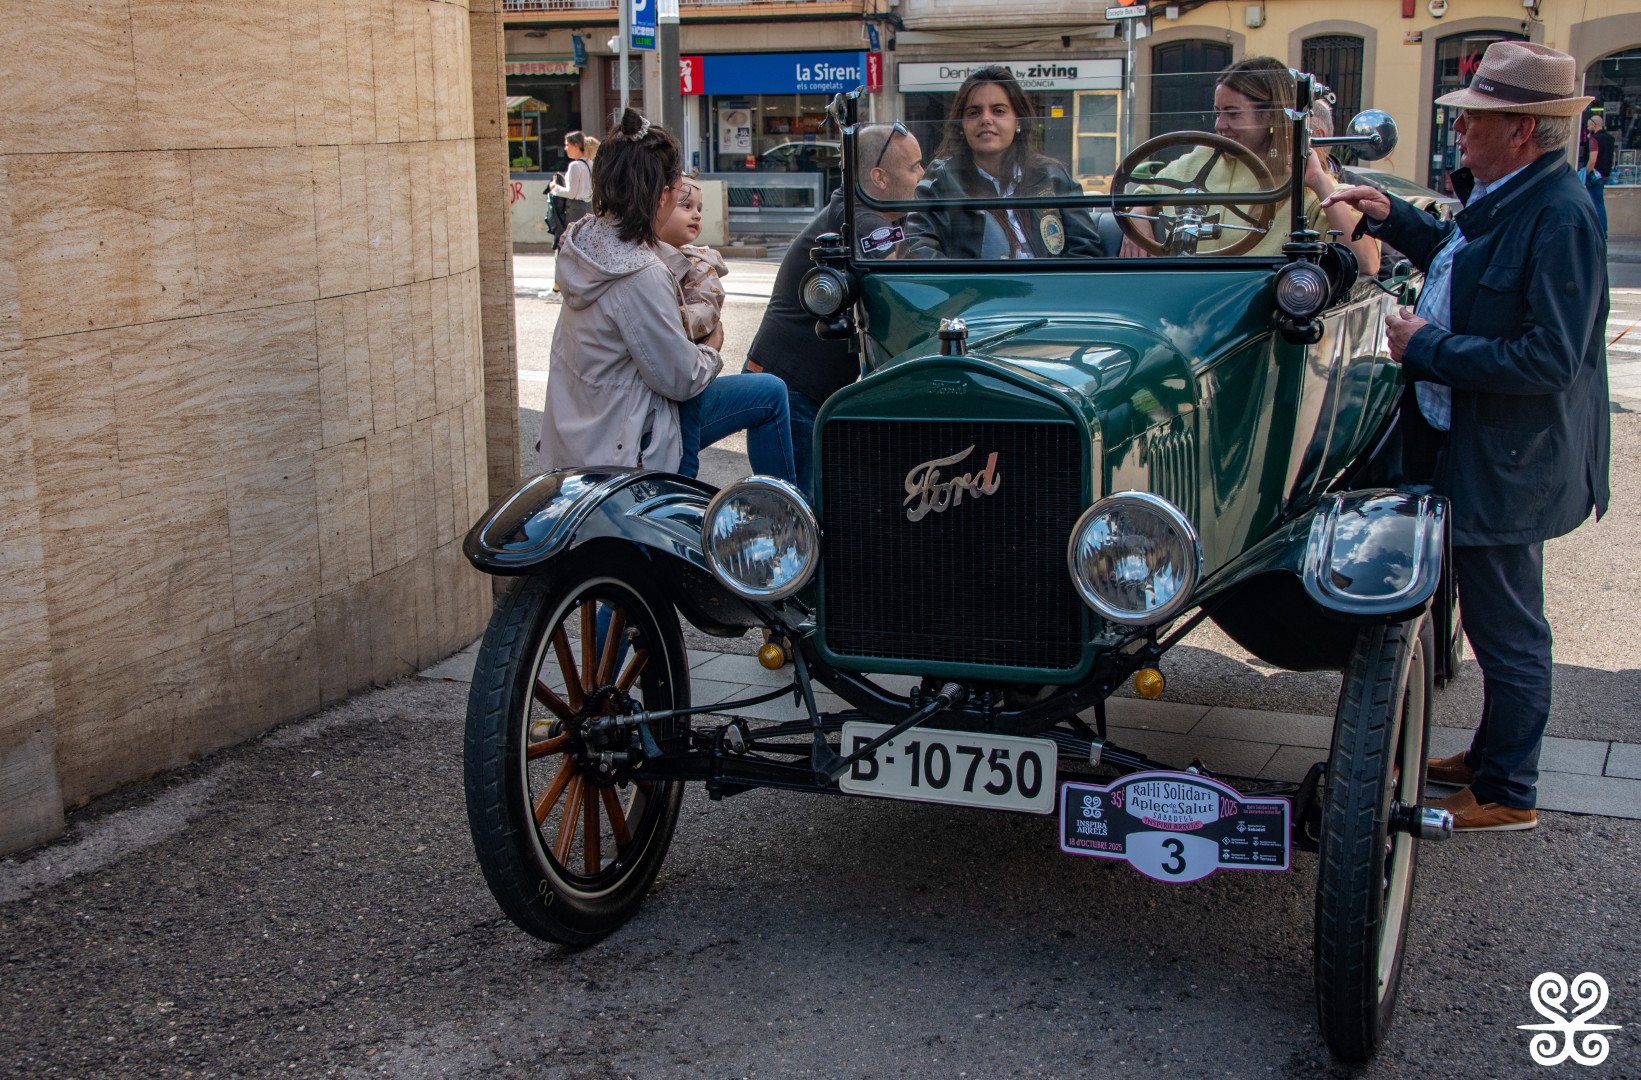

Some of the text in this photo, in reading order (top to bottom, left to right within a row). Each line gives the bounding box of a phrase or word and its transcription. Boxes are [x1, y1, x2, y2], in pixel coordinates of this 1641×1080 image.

[631, 0, 647, 25] P
[519, 62, 569, 74] MERCAT
[796, 63, 811, 81] la
[1016, 69, 1026, 78] by
[1027, 64, 1078, 79] ziving
[796, 81, 844, 91] els congelats
[903, 444, 1001, 522] Ford
[850, 735, 1043, 799] B-10750
[1163, 783, 1211, 801] Solidari
[1131, 797, 1169, 813] Aplec
[1178, 802, 1214, 815] Salut
[1220, 796, 1238, 818] 2025
[1076, 819, 1108, 830] INSPIRA
[1144, 817, 1200, 831] INSPIRA ARRELS
[1152, 812, 1194, 822] SABADELL
[1076, 826, 1108, 836] ARRELS
[1108, 842, 1123, 851] 2025
[1160, 838, 1187, 876] 3
